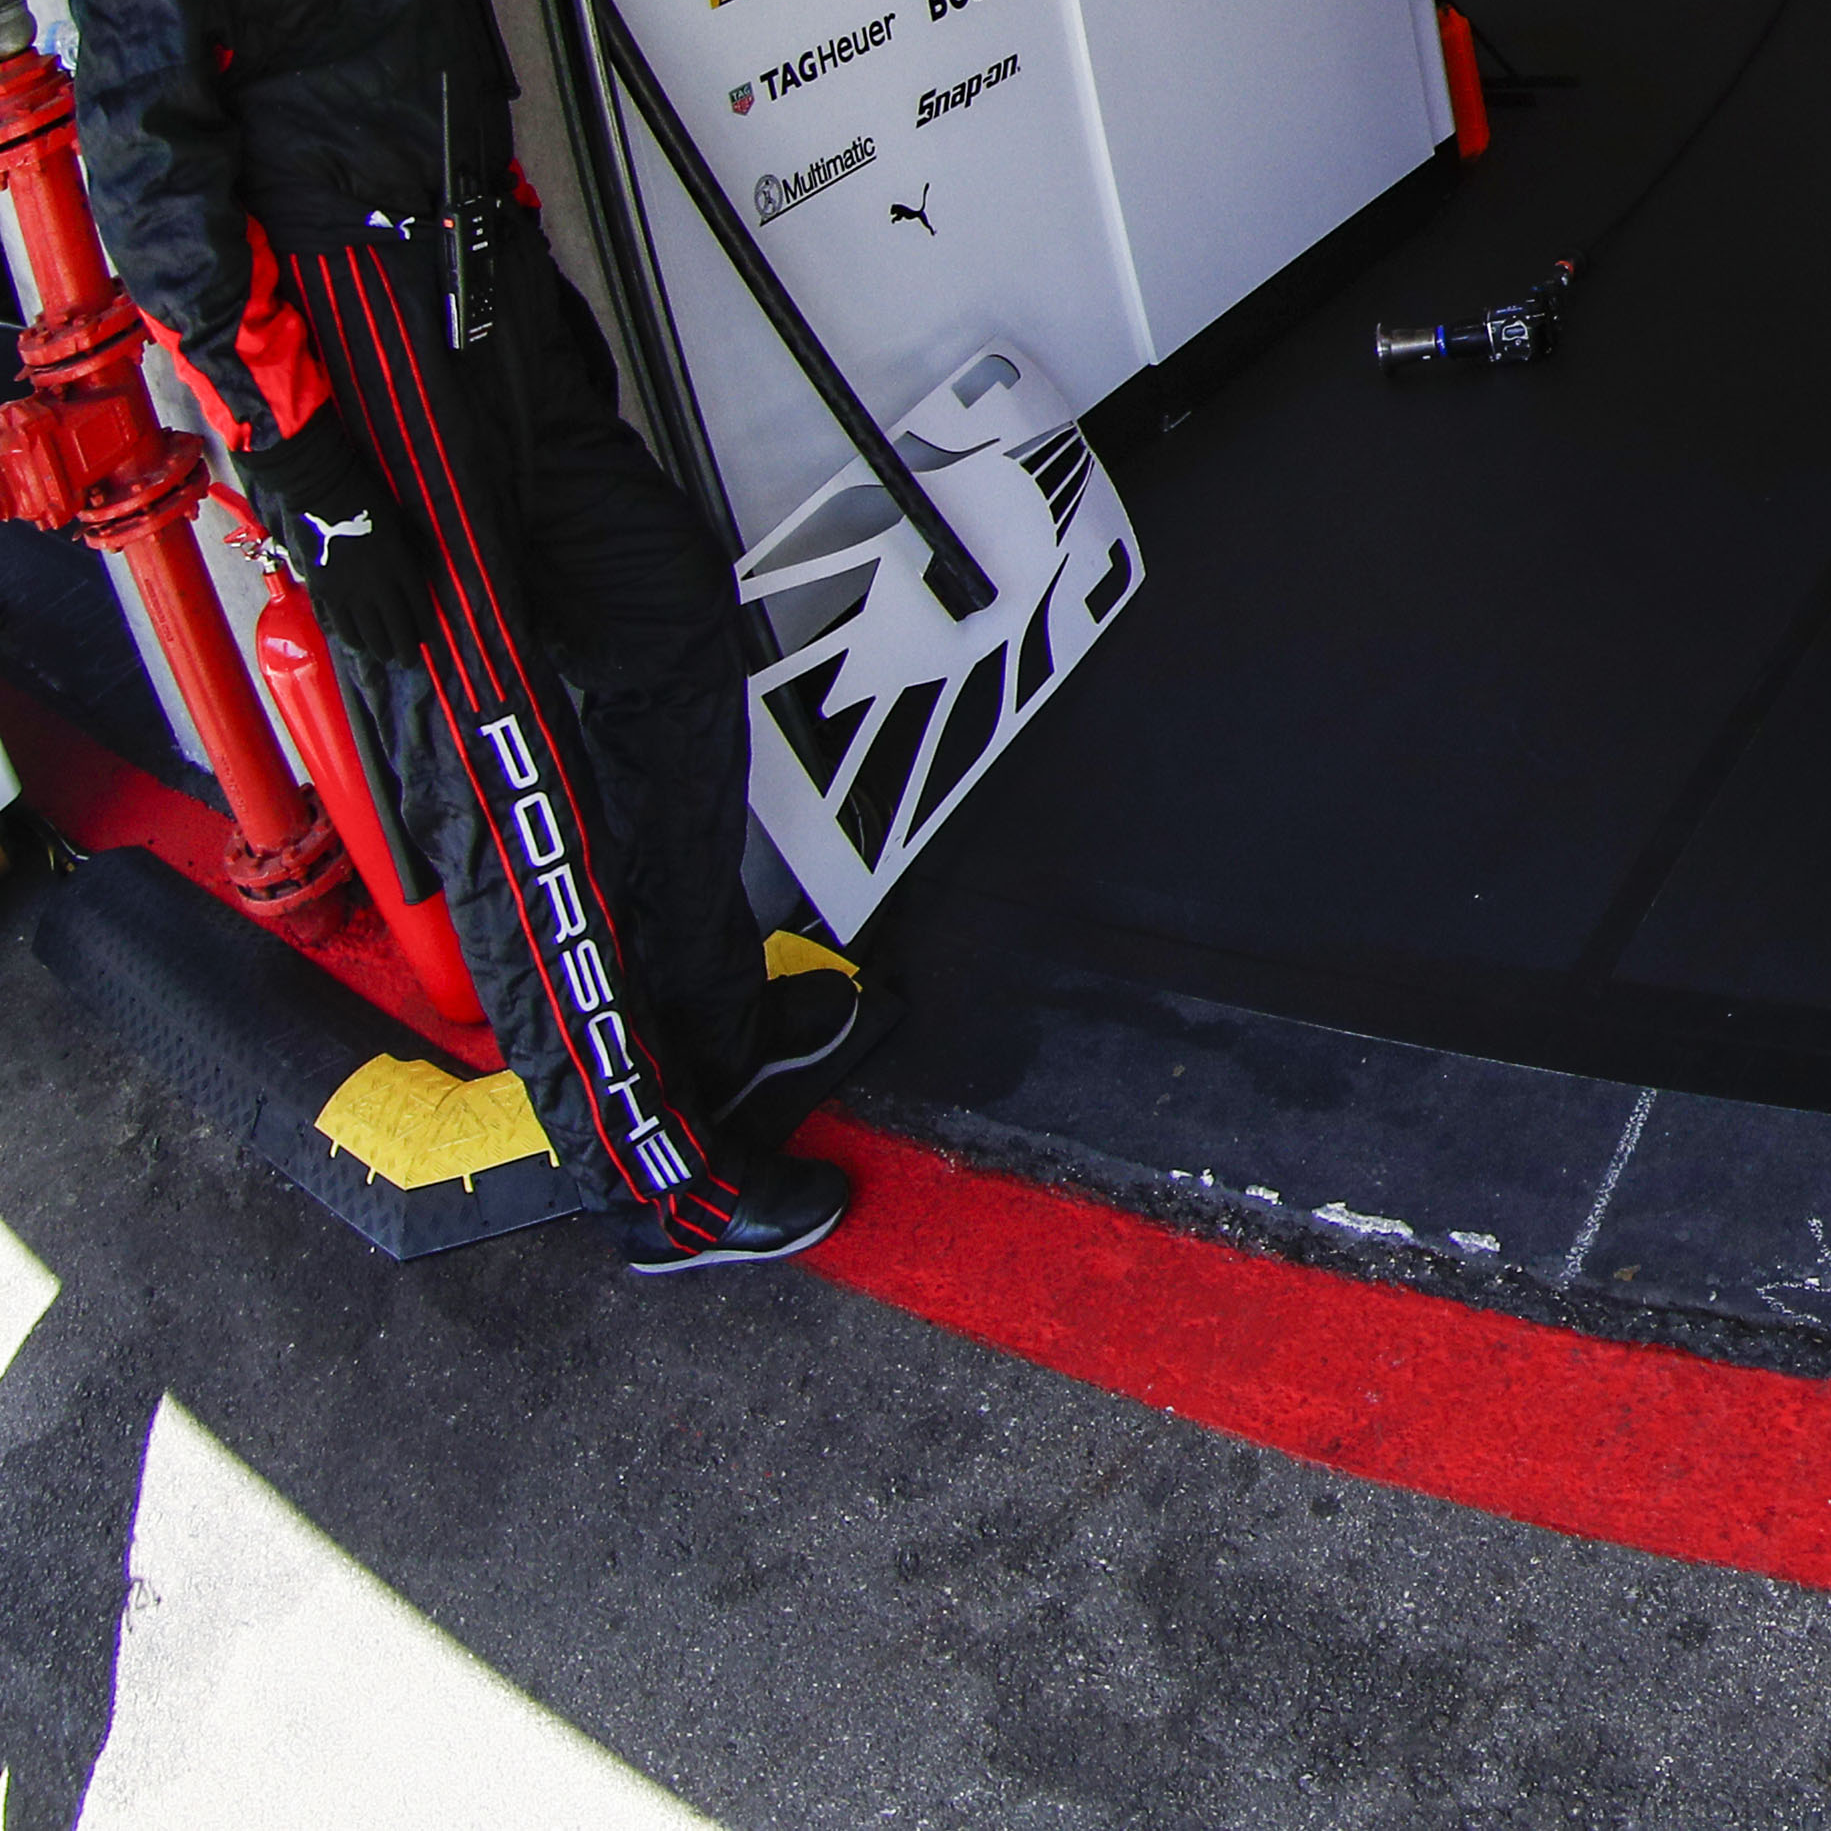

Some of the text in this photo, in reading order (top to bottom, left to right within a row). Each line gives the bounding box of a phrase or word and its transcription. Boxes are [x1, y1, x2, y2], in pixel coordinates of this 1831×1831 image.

[916, 53, 1020, 128] Snap-on
[782, 136, 876, 204] Multimatic
[480, 713, 692, 1191] PORSCHE
